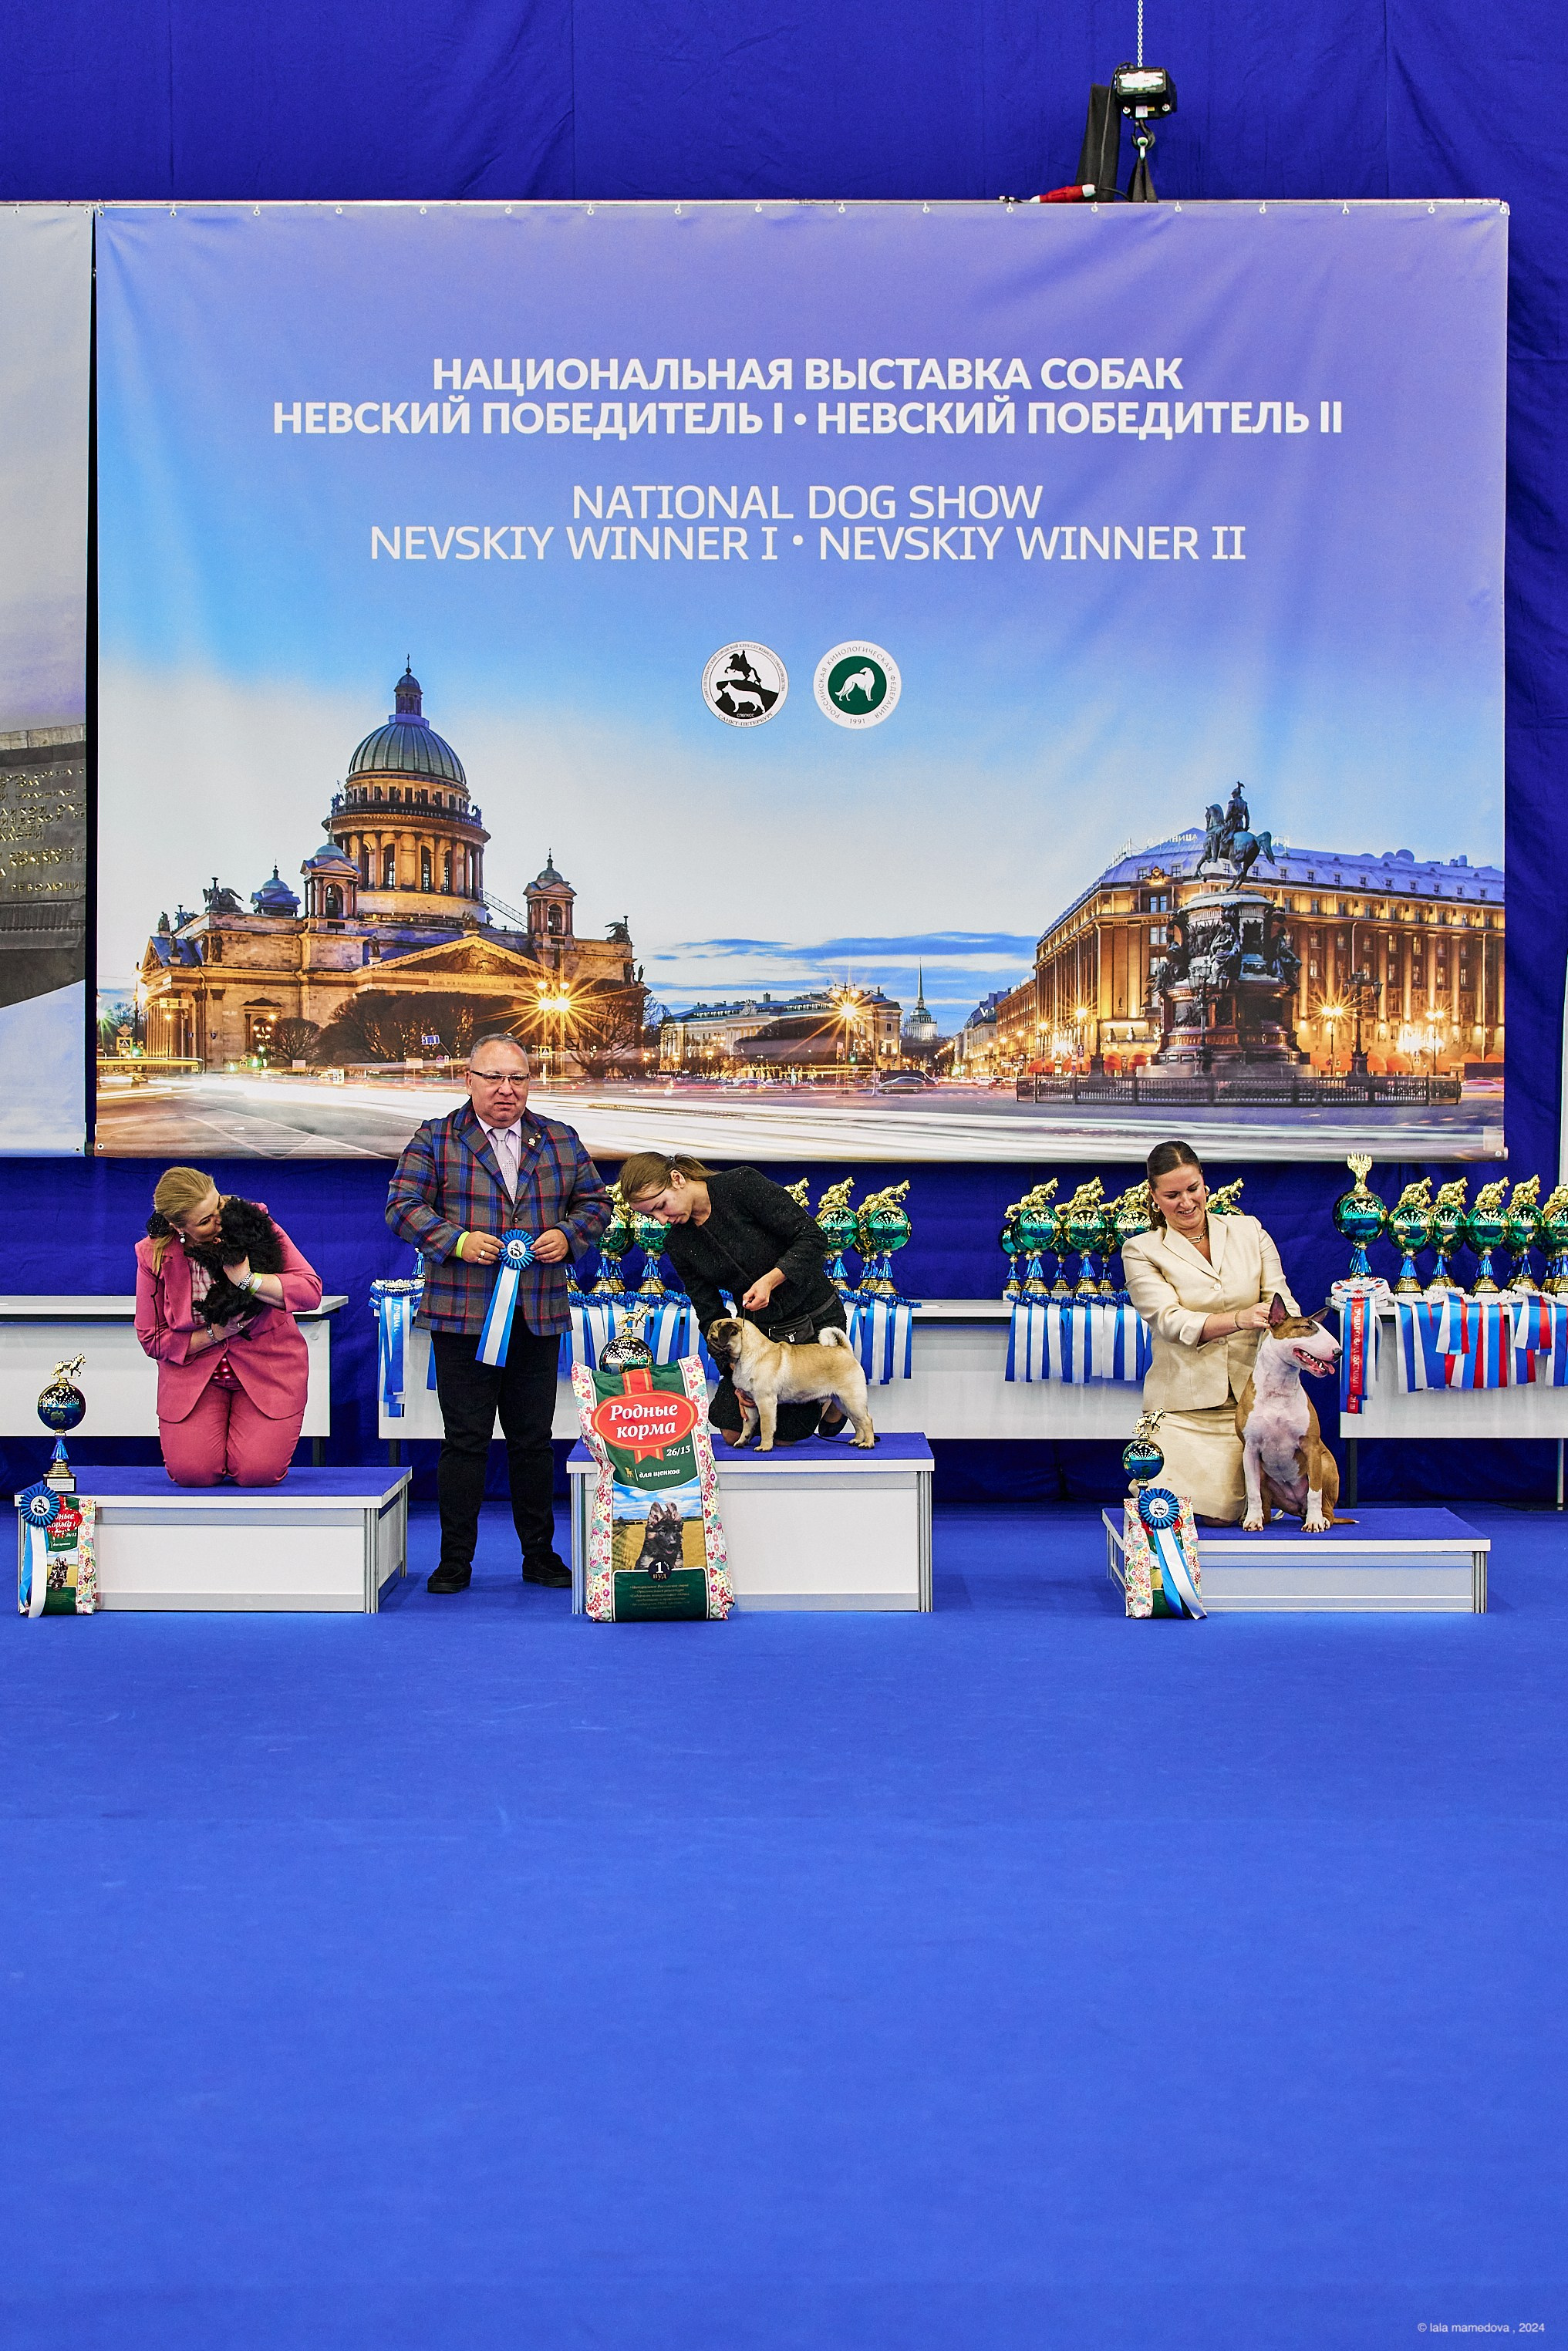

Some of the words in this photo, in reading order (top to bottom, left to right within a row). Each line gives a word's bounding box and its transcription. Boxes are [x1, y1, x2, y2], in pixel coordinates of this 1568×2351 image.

[434, 359, 793, 396] НАЦИОНАЛЬНАЯ
[806, 359, 1031, 390] ВЫСТАВКА
[1041, 358, 1183, 390] СОБАК
[274, 395, 470, 433] НЕВСКИЙ
[484, 402, 763, 440] ПОБЕДИТЕЛЬ
[774, 403, 783, 433] I
[818, 395, 1015, 433] НЕВСКИЙ
[1029, 402, 1309, 440] ПОБЕДИТЕЛЬ
[1321, 402, 1342, 432] II
[574, 486, 794, 519] NATIONAL
[809, 486, 895, 519] DOG
[909, 486, 1044, 519] SHOW
[372, 526, 554, 560] NEVSKIY
[566, 527, 748, 560] WINNER
[761, 527, 777, 560] I
[821, 527, 1004, 560] NEVSKIY
[1016, 527, 1199, 560] WINNER
[1212, 527, 1246, 560] II
[826, 646, 893, 672] КИНОЛОГИЧЕСКАЯ
[818, 667, 841, 719] РОССИЙСКАЯ
[875, 675, 897, 719] ФЕДЕРАЦИЯ
[718, 712, 773, 727] САНКТ-ПЕТЕРБУРГ
[609, 1403, 679, 1421] Родные
[616, 1422, 676, 1440] корма
[666, 1445, 691, 1457] 26/13
[653, 1469, 680, 1477] щенков
[655, 1561, 664, 1574] 1
